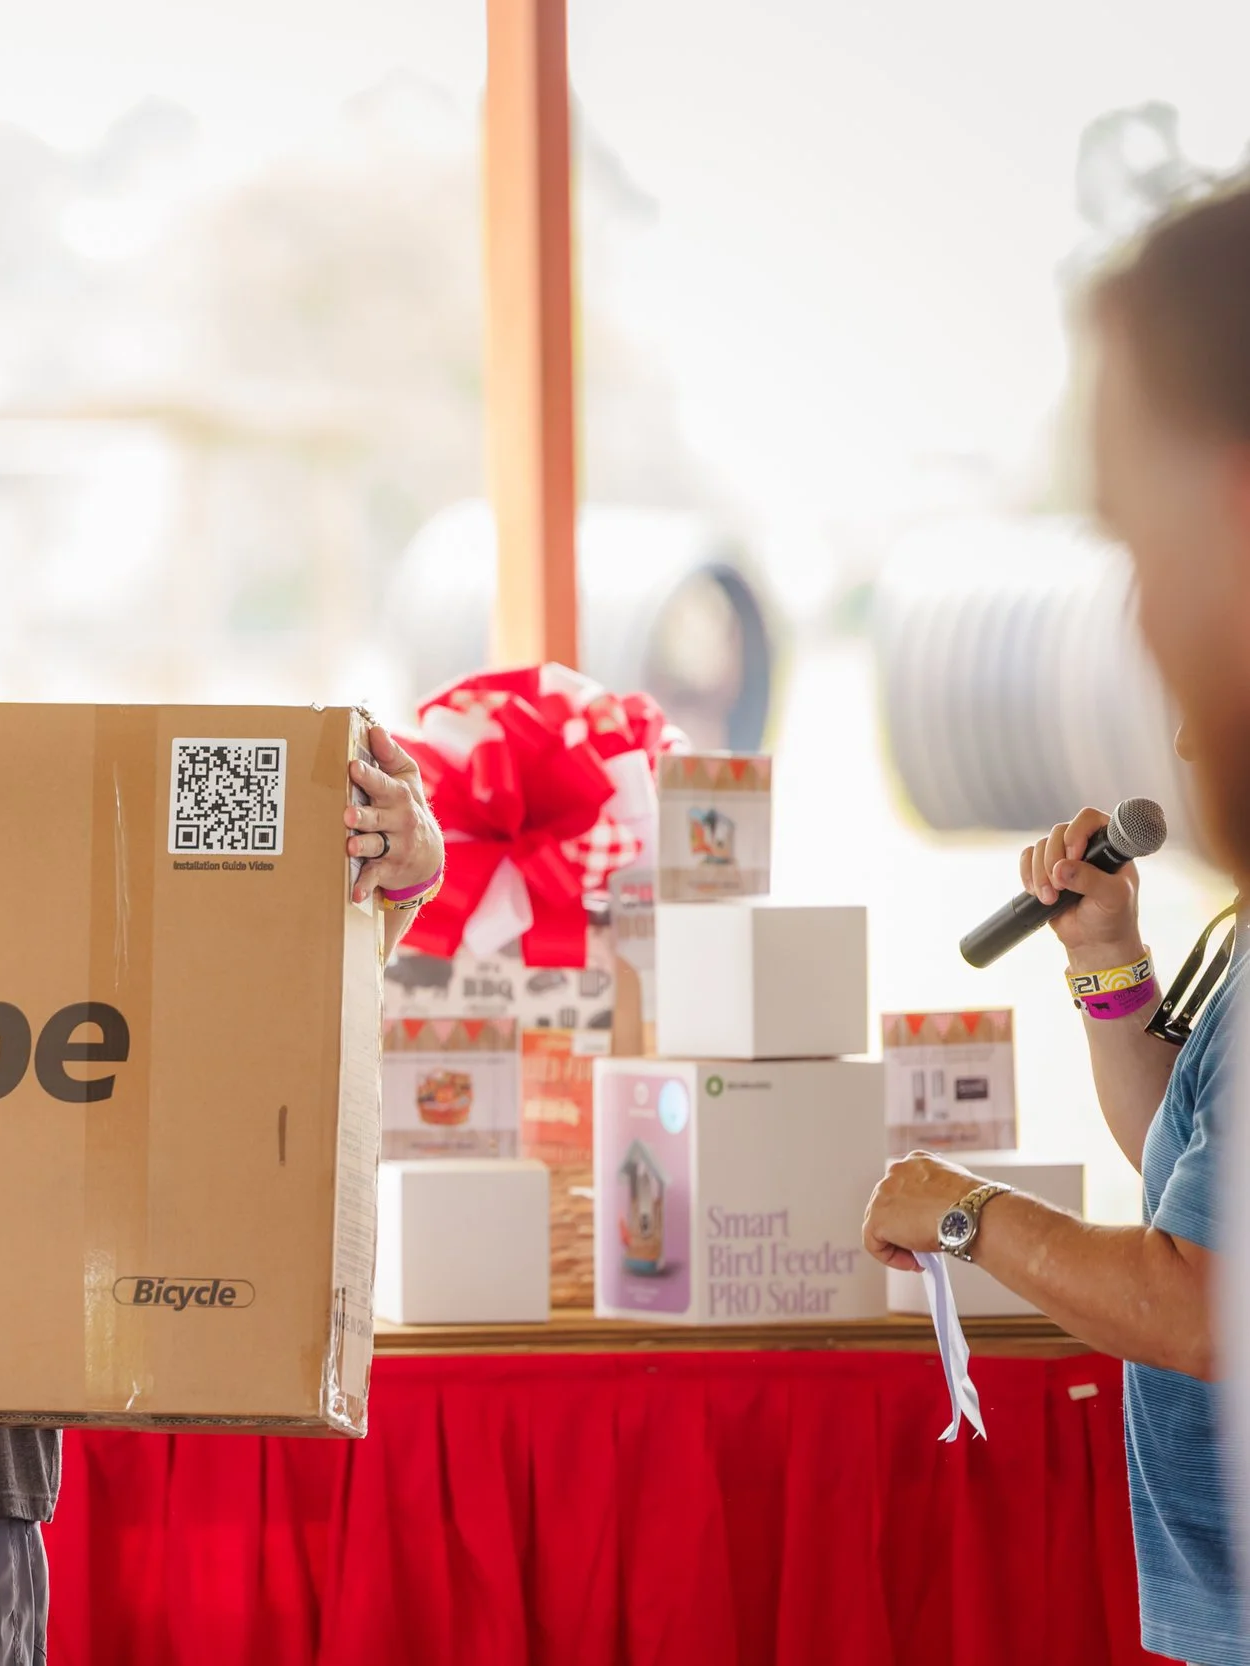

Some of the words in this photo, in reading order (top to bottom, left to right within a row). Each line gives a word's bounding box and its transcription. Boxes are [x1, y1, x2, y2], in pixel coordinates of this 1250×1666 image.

[173, 860, 220, 871] Installation
[222, 861, 247, 871] Guide
[249, 861, 275, 871] Video
[1075, 974, 1101, 994] 21
[1137, 959, 1151, 981] 2
[463, 978, 514, 1001] BBQ
[707, 1205, 790, 1239] Smart
[707, 1243, 764, 1278] Bird
[770, 1241, 861, 1276] Feeder
[132, 1279, 237, 1312] Bicycle
[707, 1282, 761, 1318] PRO
[766, 1280, 839, 1315] Solar
